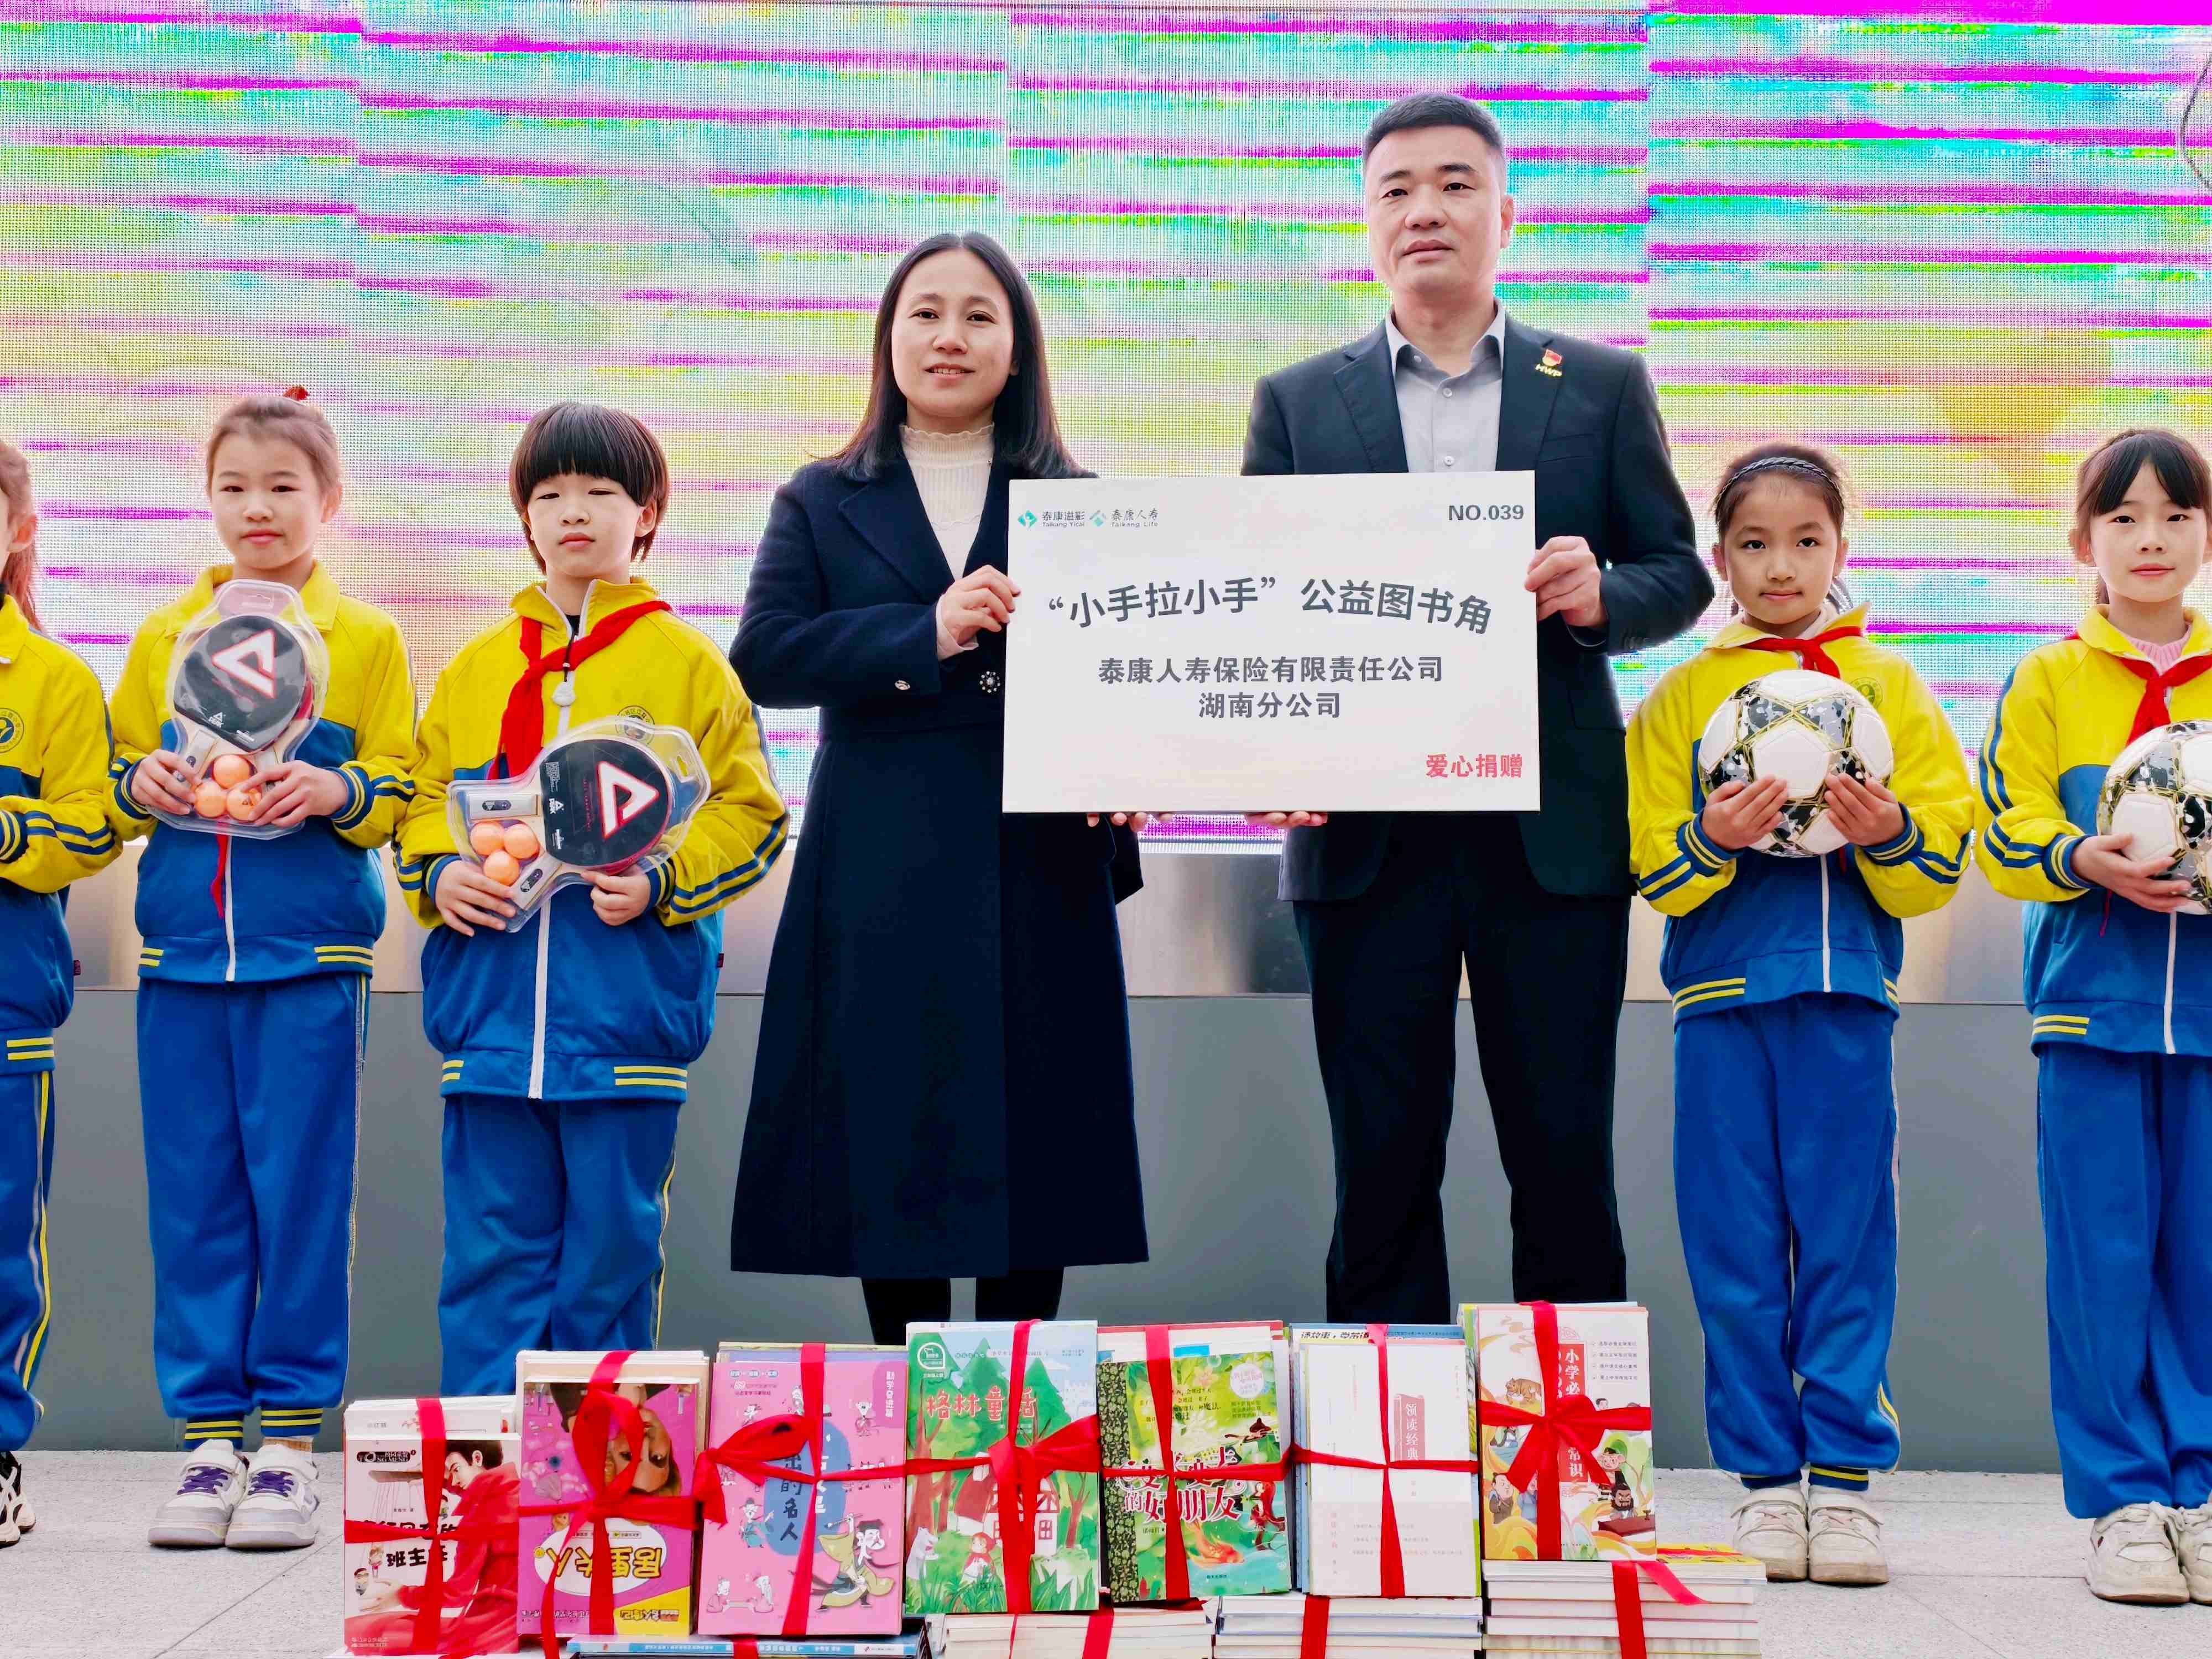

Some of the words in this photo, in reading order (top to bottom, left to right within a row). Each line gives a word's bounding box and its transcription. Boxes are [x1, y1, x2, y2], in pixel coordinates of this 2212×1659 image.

[1042, 510, 1085, 521] 泰康溢彩
[1110, 508, 1159, 521] 泰康人寿
[1448, 504, 1525, 521] NO.039
[1099, 656, 1443, 684] 泰康人寿保险有限责任公司
[1199, 692, 1341, 719] 湖南分公司
[1426, 754, 1524, 779] 爱心捐赠
[1406, 1403, 1419, 1460] 领读经典
